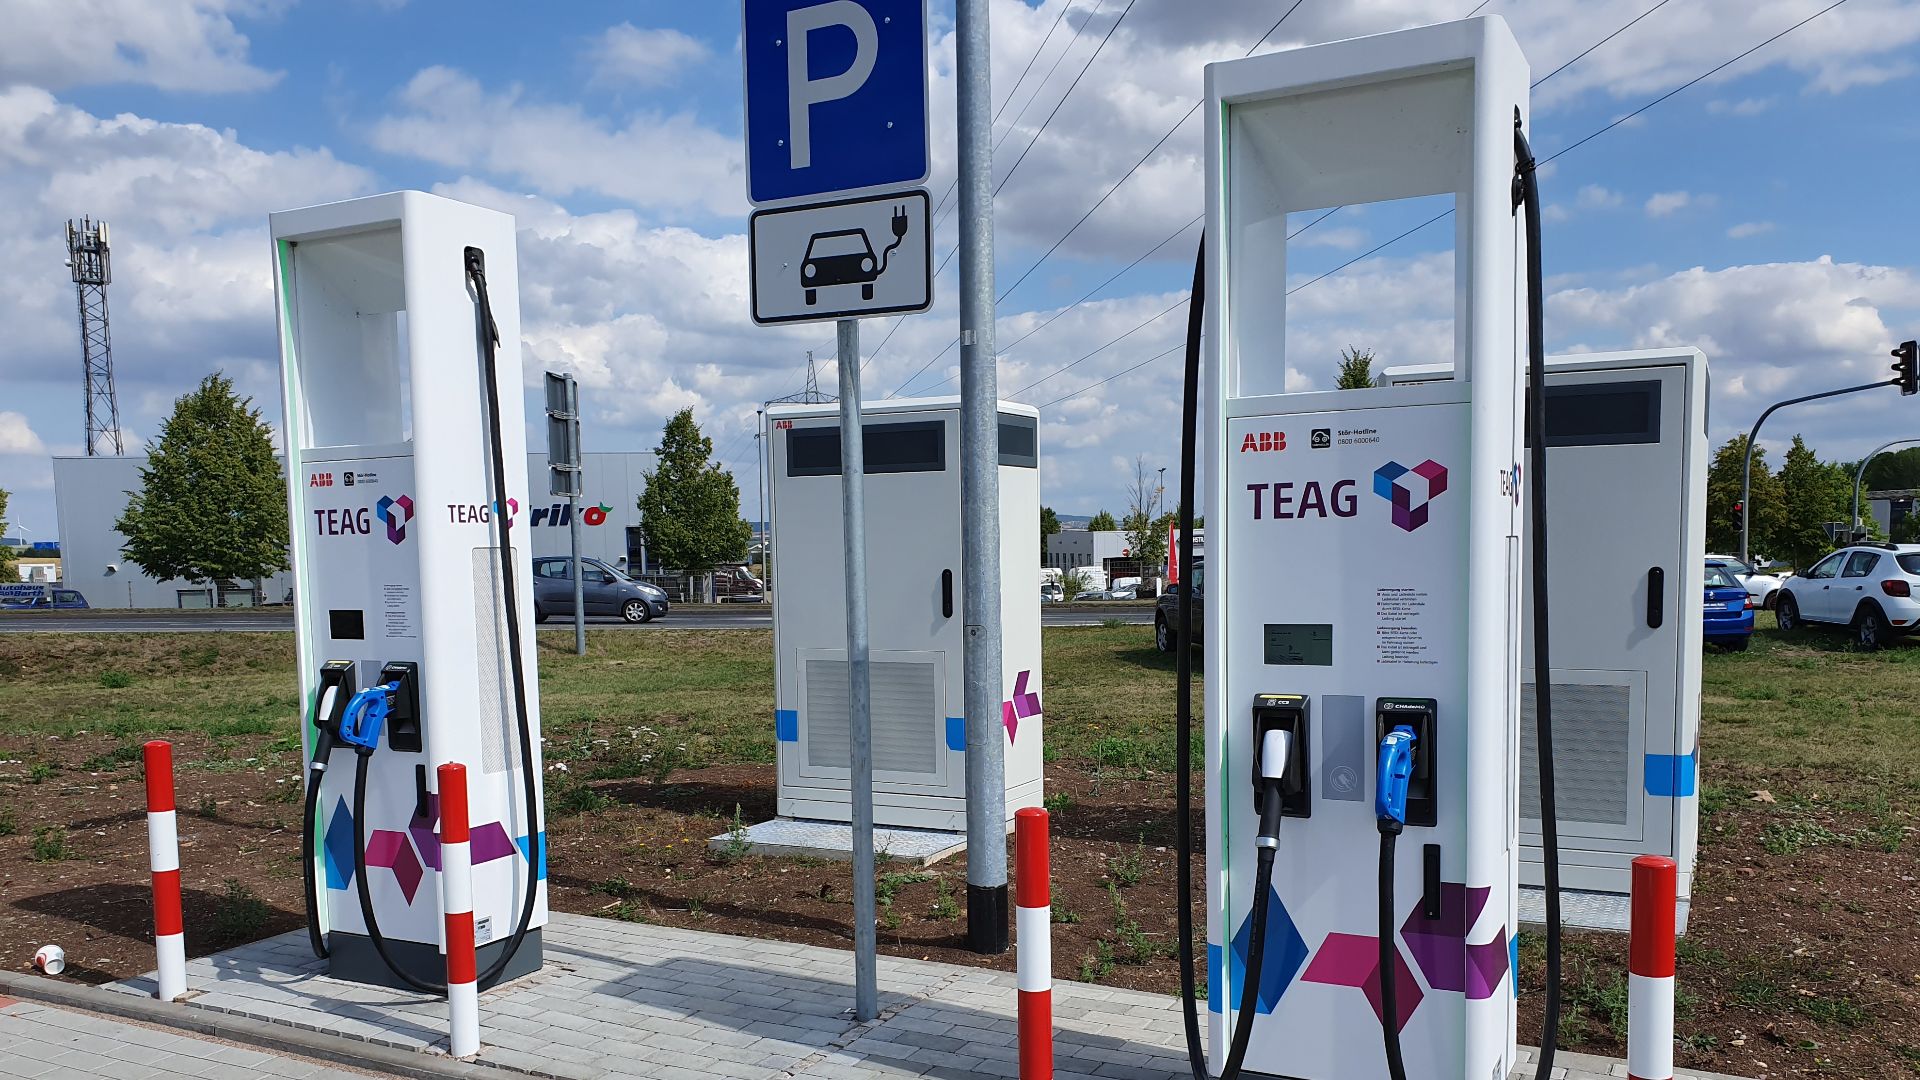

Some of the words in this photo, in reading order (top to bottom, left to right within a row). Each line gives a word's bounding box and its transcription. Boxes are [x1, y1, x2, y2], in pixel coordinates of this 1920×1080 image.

[786, 0, 878, 169] P
[775, 420, 793, 430] ABB
[1240, 431, 1287, 453] ABB
[310, 473, 333, 488] ABB
[1500, 469, 1513, 496] TEAG
[1246, 479, 1358, 520] TEAG
[313, 507, 371, 536] TEAG
[448, 504, 489, 524] TEAG
